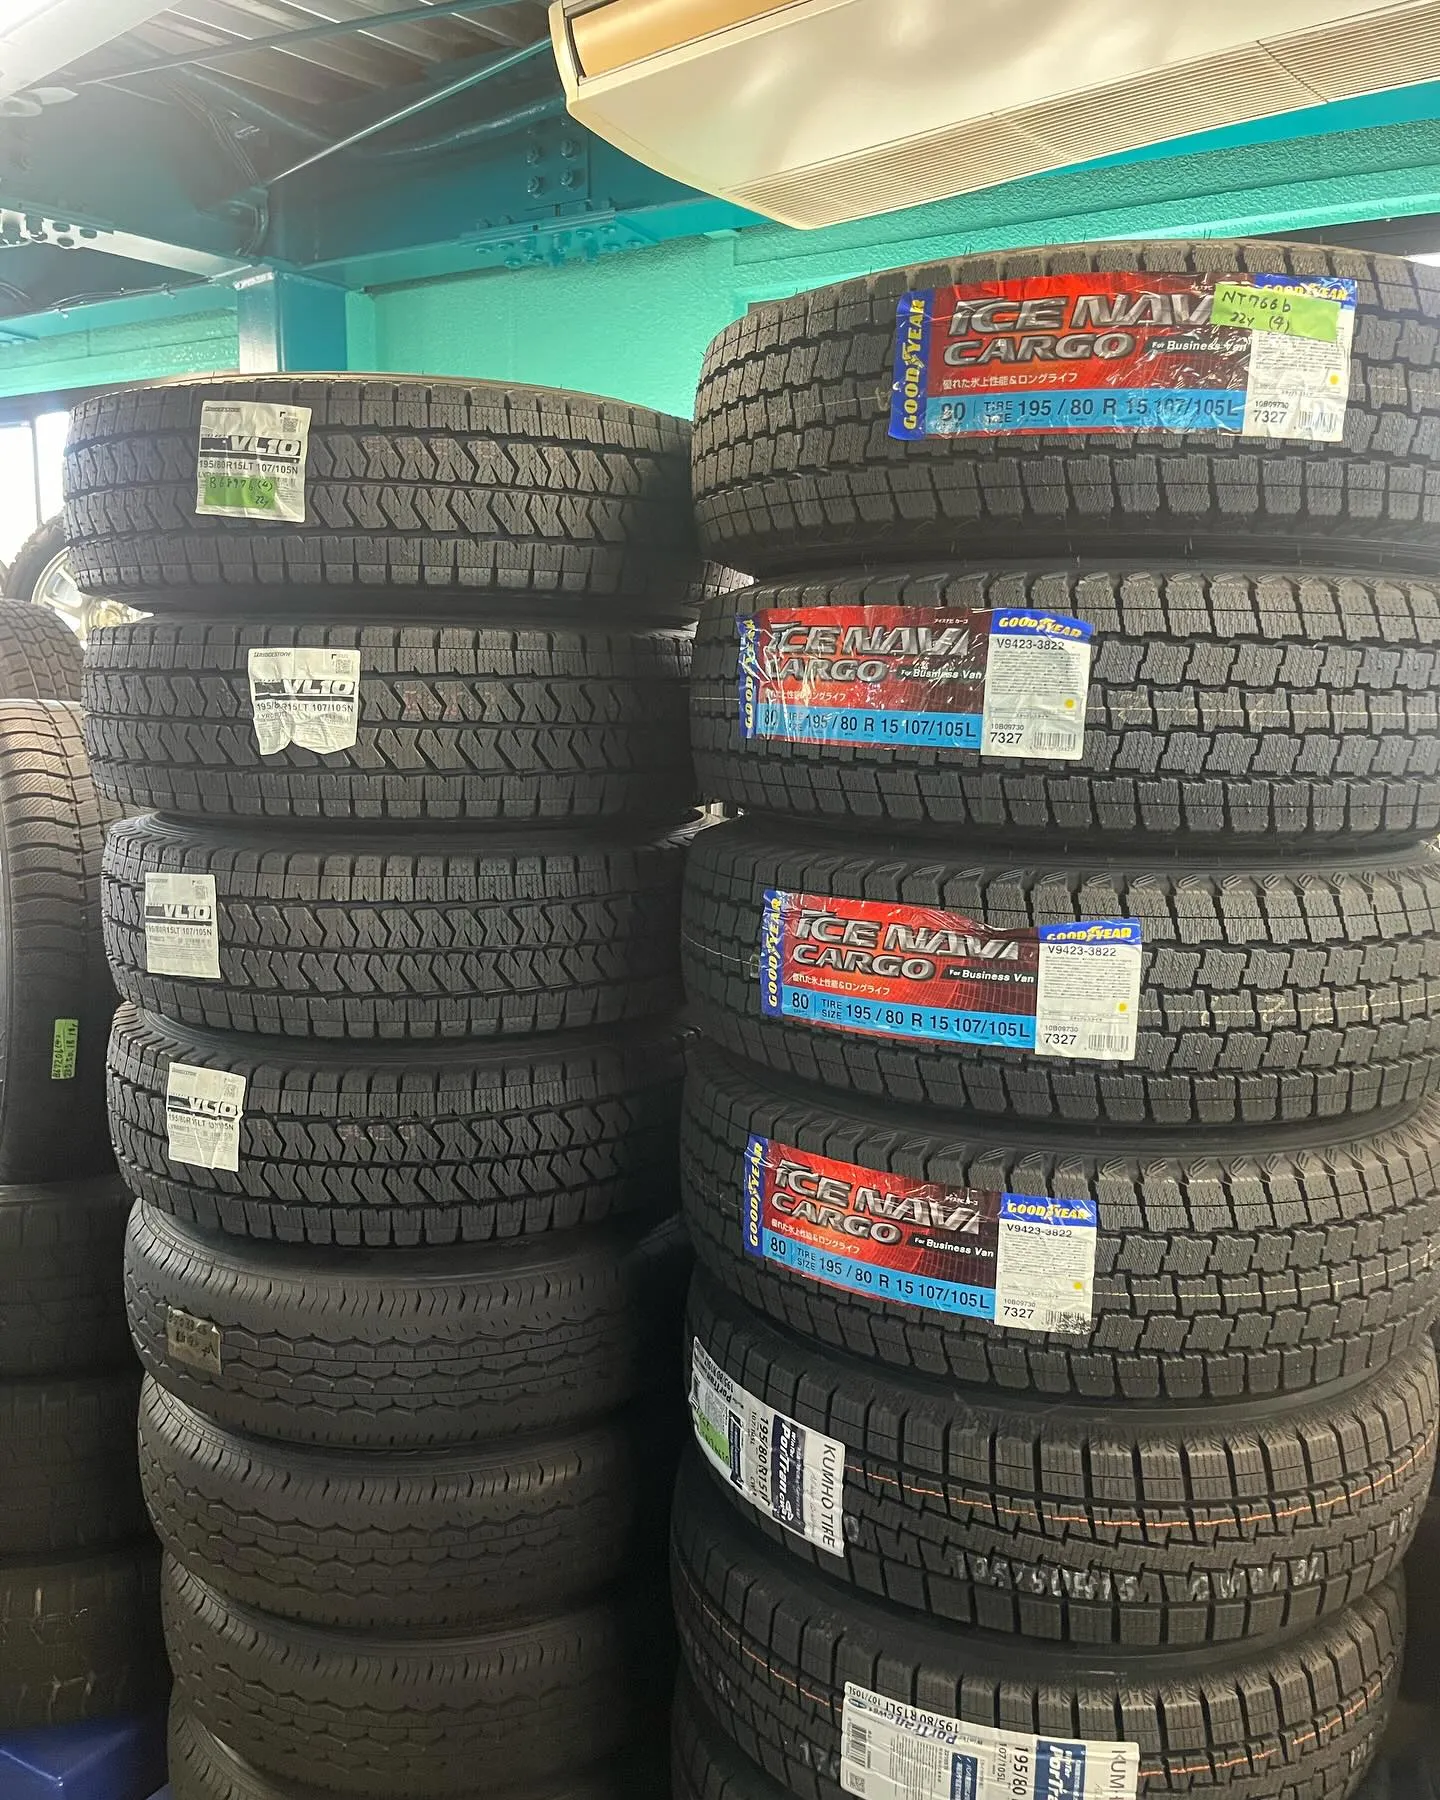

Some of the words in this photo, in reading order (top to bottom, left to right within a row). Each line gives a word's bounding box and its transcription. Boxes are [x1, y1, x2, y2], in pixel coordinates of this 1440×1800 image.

[948, 295, 1069, 337] ICE
[1069, 293, 1213, 329] NAV
[943, 332, 1136, 367] CARGO
[1152, 340, 1165, 349] For
[1166, 339, 1221, 352] Business
[903, 299, 926, 430] GOODYEAR
[1018, 400, 1052, 416] 195
[1070, 399, 1094, 414] 80
[1103, 399, 1116, 414] R
[1126, 399, 1149, 415] 15
[1253, 410, 1288, 424] 7327
[230, 435, 301, 457] VL10
[998, 616, 1083, 638] GOODYEAR
[764, 621, 842, 654] ICE
[997, 637, 1065, 651] V9423-3822
[912, 668, 959, 679] Business
[962, 669, 982, 679] Van
[282, 679, 356, 695] VL10
[312, 703, 354, 713] 107/105N
[806, 712, 828, 729] 195
[840, 716, 858, 731] 80
[864, 717, 874, 732] R
[881, 719, 899, 734] 15
[904, 719, 976, 738] 107/105L
[989, 731, 1023, 744] 7327
[163, 904, 212, 919] VL10
[795, 909, 882, 948] ICE
[1046, 926, 1132, 942] GOODYEAR
[767, 898, 782, 1007] GOODYEAR
[1047, 945, 1117, 957] V9423-3822
[792, 943, 937, 982] CARGO
[949, 969, 961, 977] For
[961, 969, 1011, 982] Business
[1013, 973, 1035, 984] Van
[792, 991, 809, 1010] 80
[821, 999, 842, 1010] TIRE
[821, 1010, 842, 1020] SIZE
[846, 1004, 871, 1020] 195
[885, 1009, 904, 1025] 80
[911, 1012, 923, 1028] R
[930, 1015, 949, 1030] 15
[953, 1018, 1031, 1038] 107/105L
[1043, 1033, 1077, 1046] 7327
[774, 1159, 853, 1209] ICE
[749, 1142, 763, 1247] GOODYEAR
[771, 1191, 903, 1245] CARGO
[1007, 1202, 1090, 1220] GOODYEAR
[1006, 1223, 1073, 1238] V9423-3822
[770, 1236, 787, 1256] 80
[797, 1248, 816, 1261] TIRE
[914, 1237, 926, 1245] For
[926, 1238, 972, 1255] Business
[975, 1246, 994, 1258] Van
[797, 1258, 816, 1271] SIZE
[819, 1256, 843, 1275] 195
[855, 1268, 873, 1284] 80
[879, 1273, 890, 1289] R
[896, 1278, 914, 1296] 15
[918, 1283, 991, 1309] 107/105L
[1003, 1305, 1034, 1319] 7327
[758, 1416, 769, 1463] 195/80
[821, 1443, 837, 1509] KUMHO
[822, 1512, 835, 1549] TIRE
[848, 1686, 882, 1705] 107/105L
[919, 1714, 959, 1734] 195/80
[996, 1743, 1008, 1782] 107/105L
[1012, 1746, 1029, 1795] 195/80
